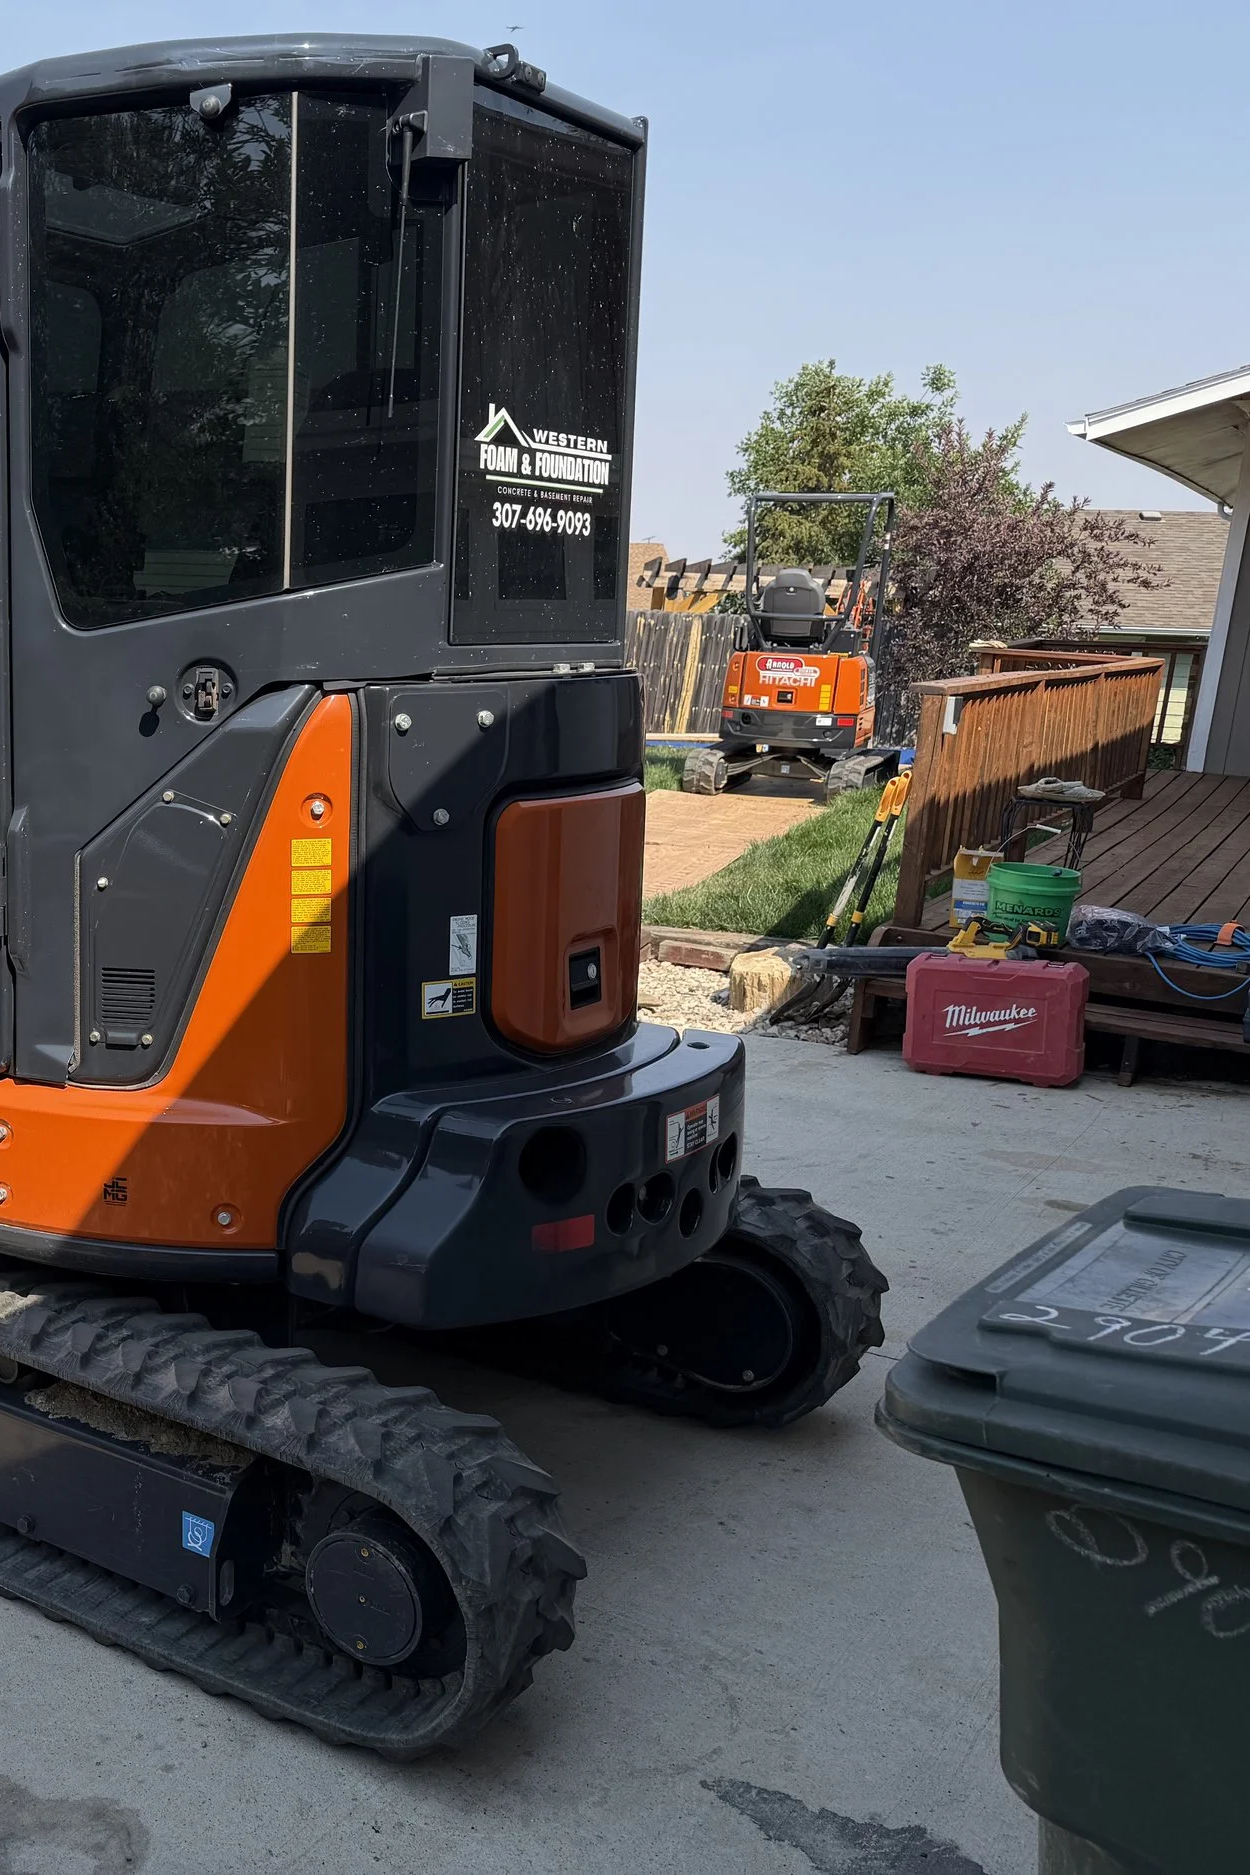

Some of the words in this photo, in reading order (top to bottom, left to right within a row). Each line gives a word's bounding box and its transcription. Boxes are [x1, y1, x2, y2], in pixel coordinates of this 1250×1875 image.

[533, 428, 608, 453] WESTERN
[479, 444, 518, 473] FOAM
[521, 453, 532, 475] &
[535, 452, 609, 485] FOUNDATION
[497, 486, 532, 498] CONCRETE
[540, 490, 571, 502] BASEMENT
[573, 494, 593, 504] REPAIR
[492, 502, 591, 537] 307-696-9093
[759, 675, 816, 687] HITACHI
[995, 901, 1062, 918] MENARDS
[942, 1003, 1038, 1028] Milwaukee
